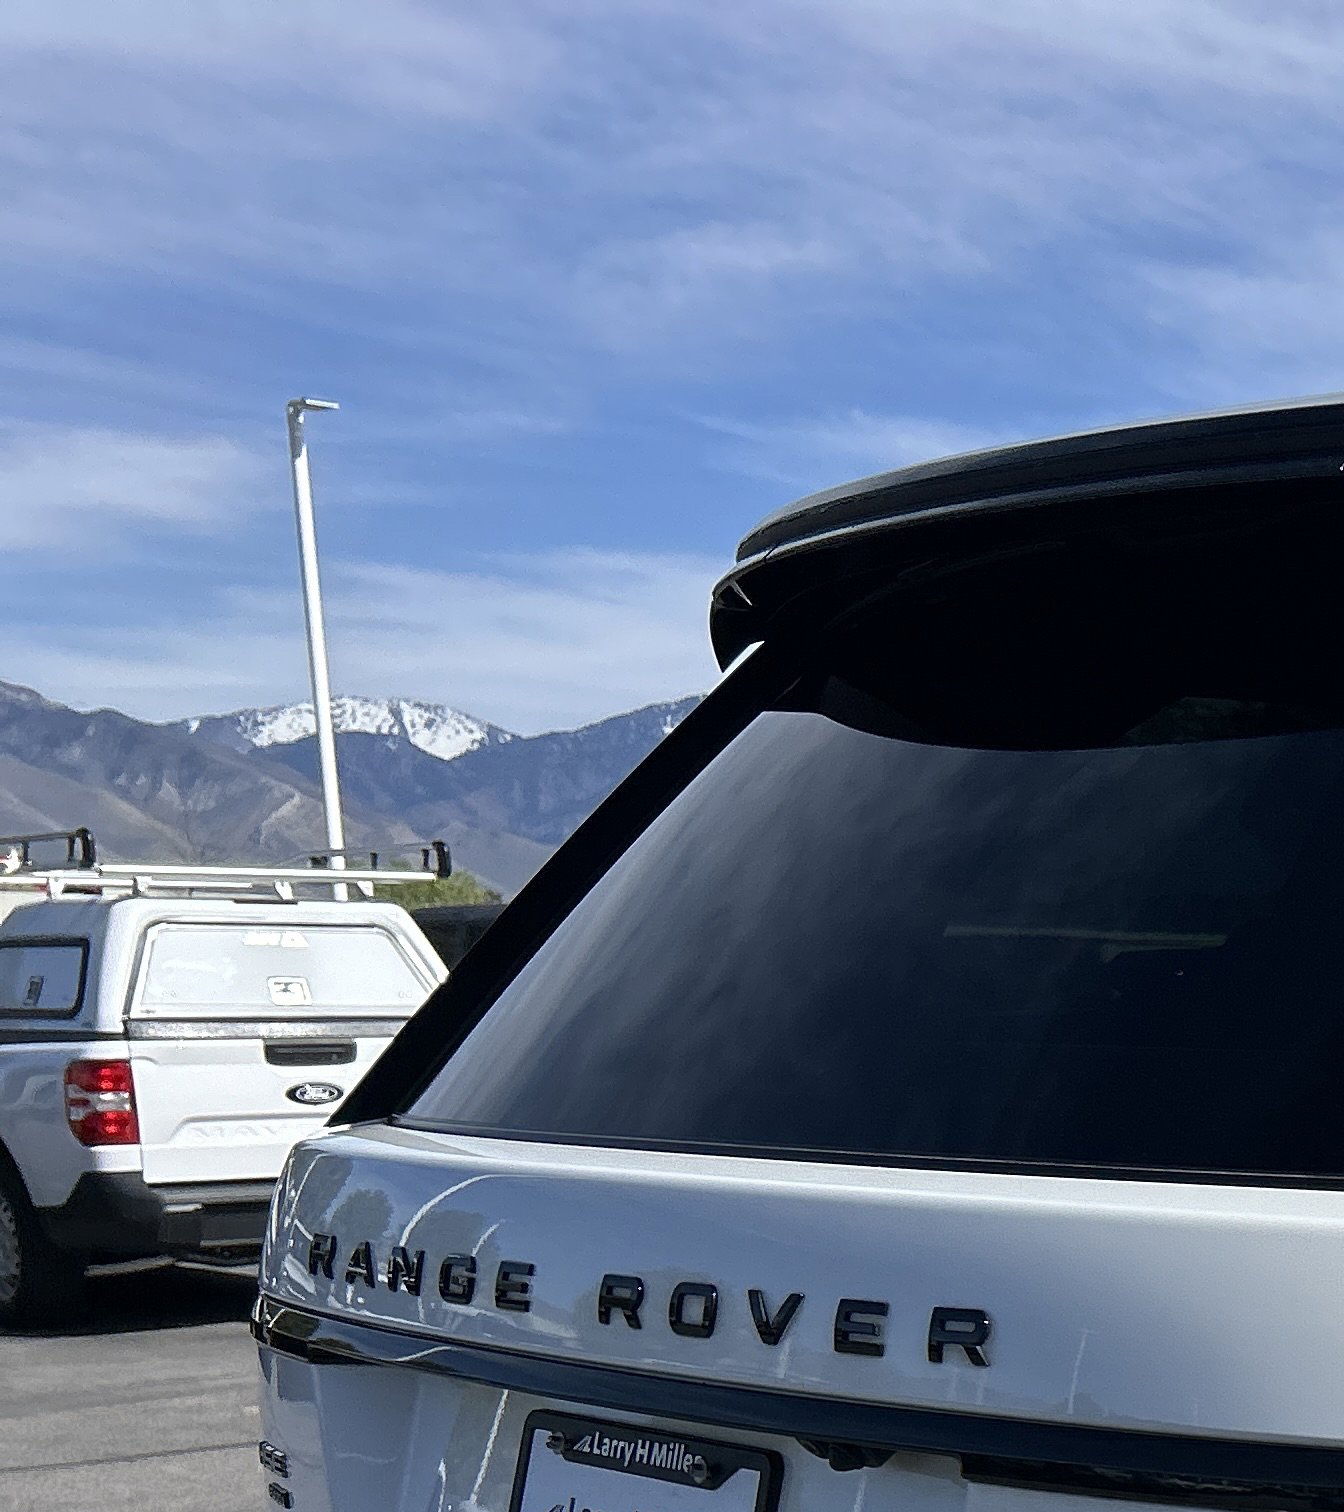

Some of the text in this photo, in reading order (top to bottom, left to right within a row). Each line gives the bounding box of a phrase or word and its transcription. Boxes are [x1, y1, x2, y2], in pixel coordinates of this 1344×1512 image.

[308, 1232, 991, 1368] RANGE ROVER
[593, 1431, 634, 1467] Larry
[636, 1439, 650, 1464] H
